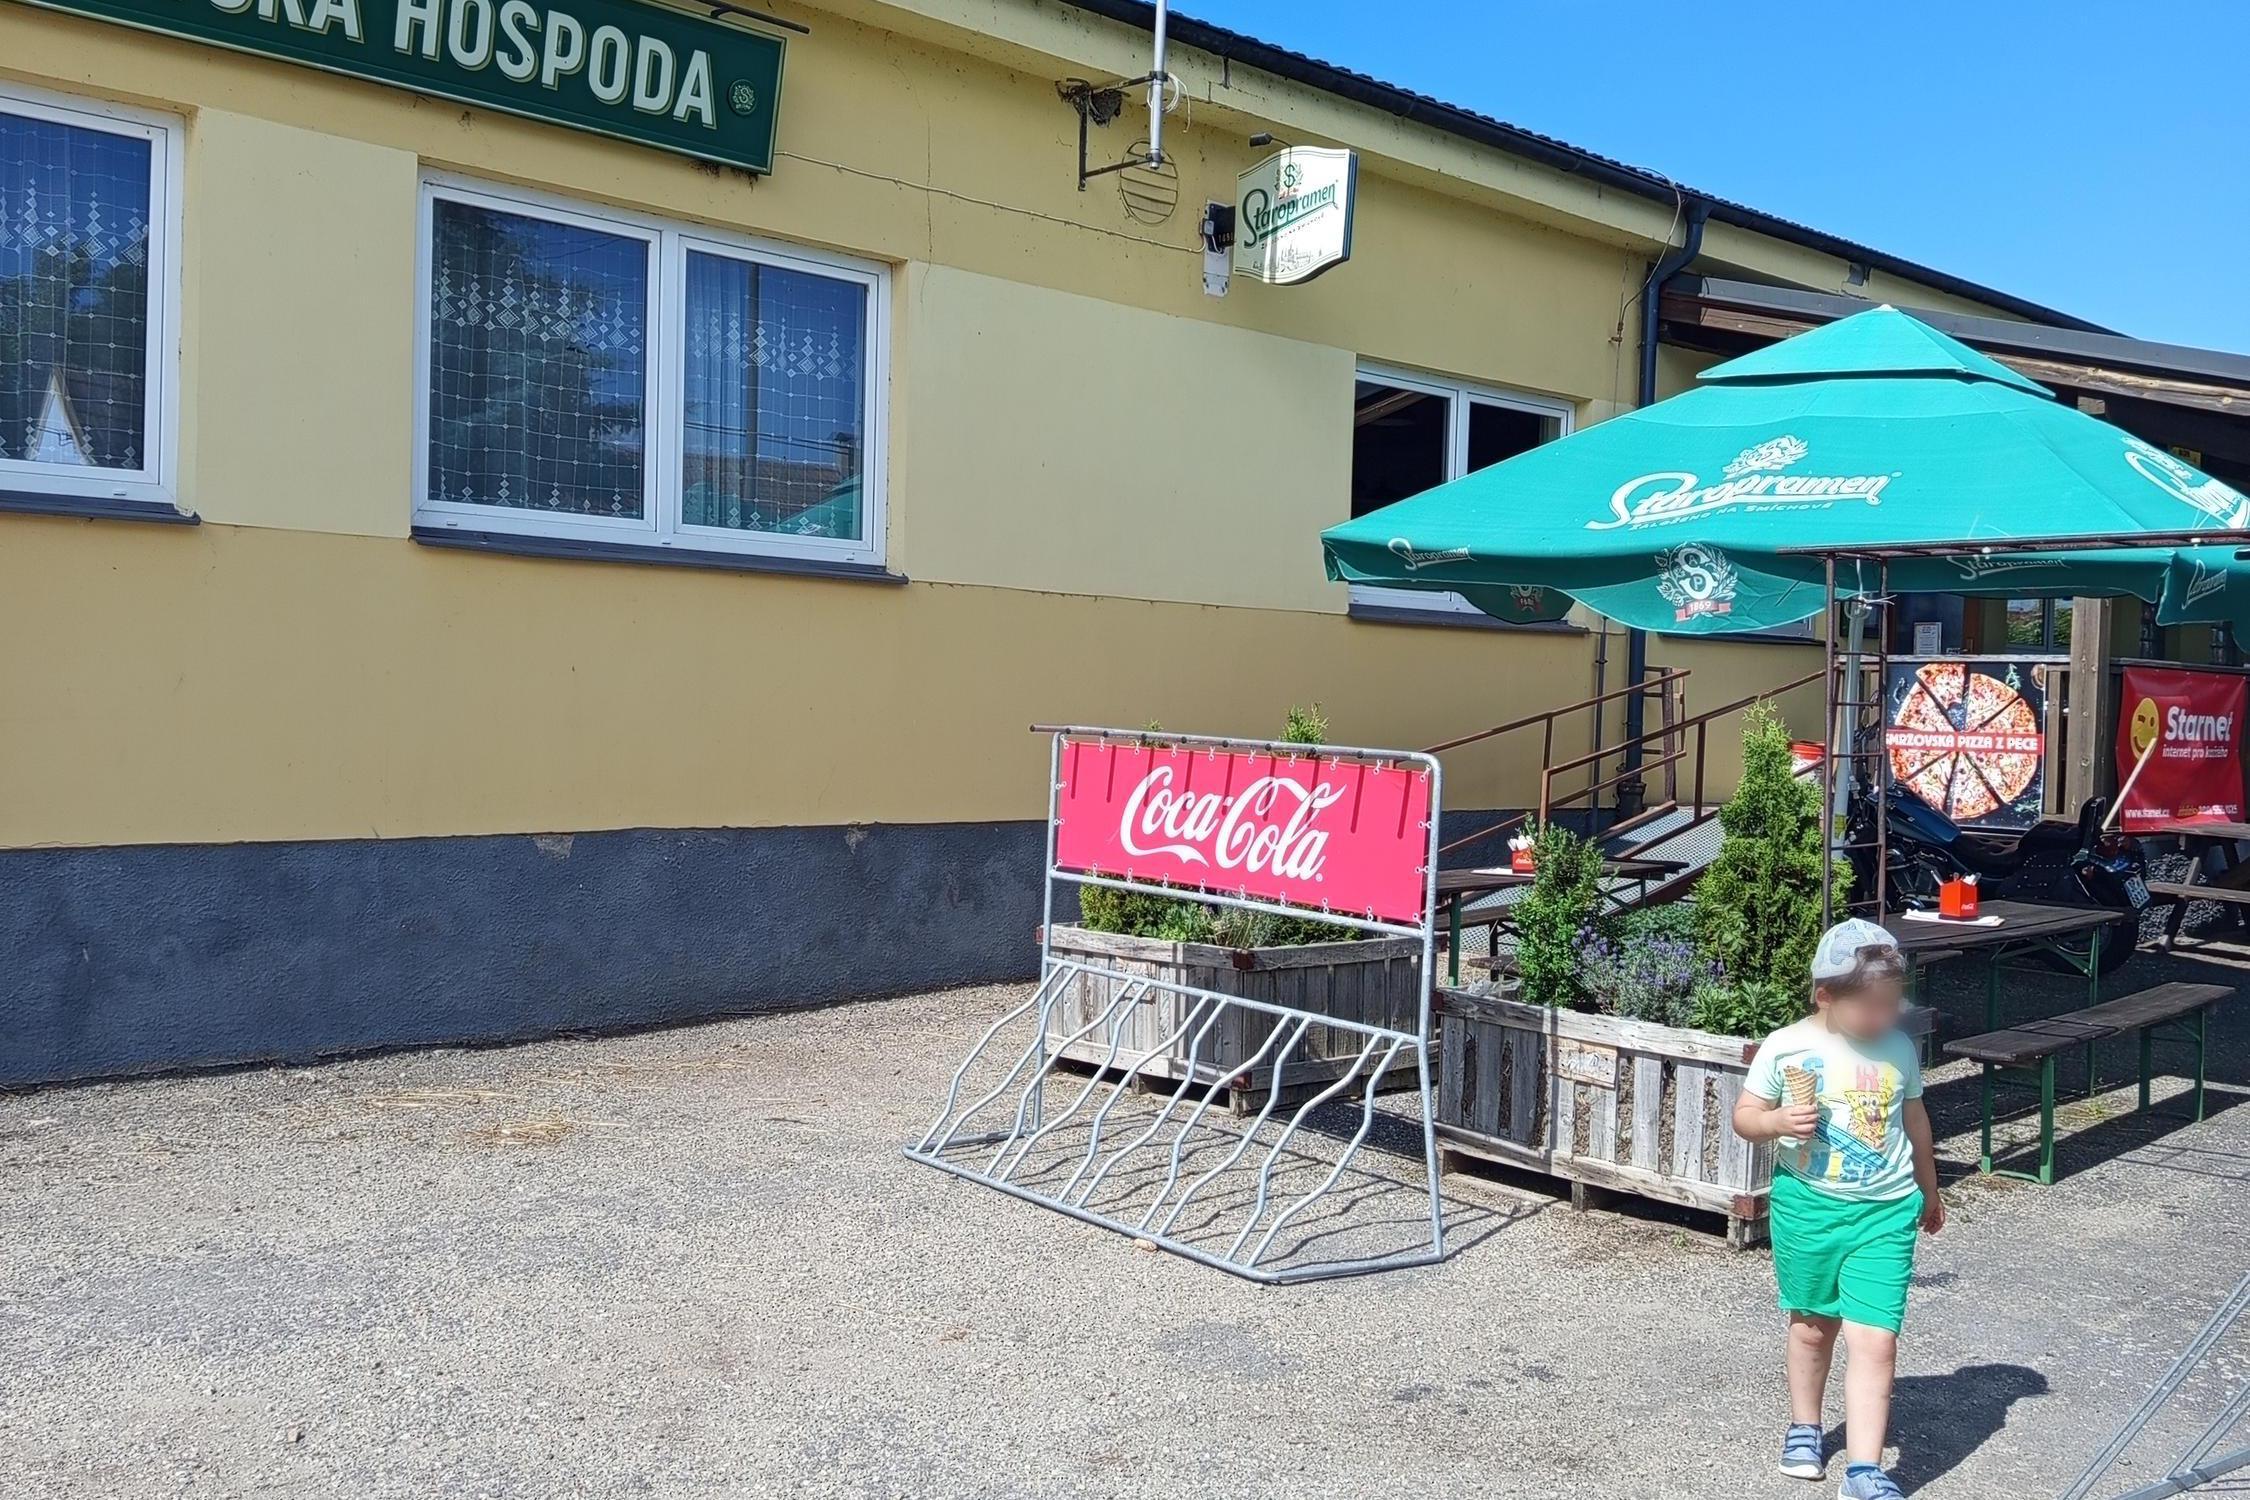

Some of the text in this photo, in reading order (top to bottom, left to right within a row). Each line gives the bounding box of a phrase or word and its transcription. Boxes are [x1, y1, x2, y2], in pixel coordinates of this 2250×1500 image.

[394, 0, 717, 130] HOSPODA
[1241, 183, 1339, 249] Staropramen
[1583, 470, 1882, 530] Staropramen
[1388, 537, 1476, 571] Staropramen
[1689, 600, 1712, 612] 1869
[2164, 706, 2234, 742] Starnet
[1958, 736, 1993, 748] PIZZA
[1994, 738, 2005, 749] Z
[2006, 738, 2039, 751] PECE
[2162, 744, 2191, 758] internet
[2191, 748, 2204, 761] pro
